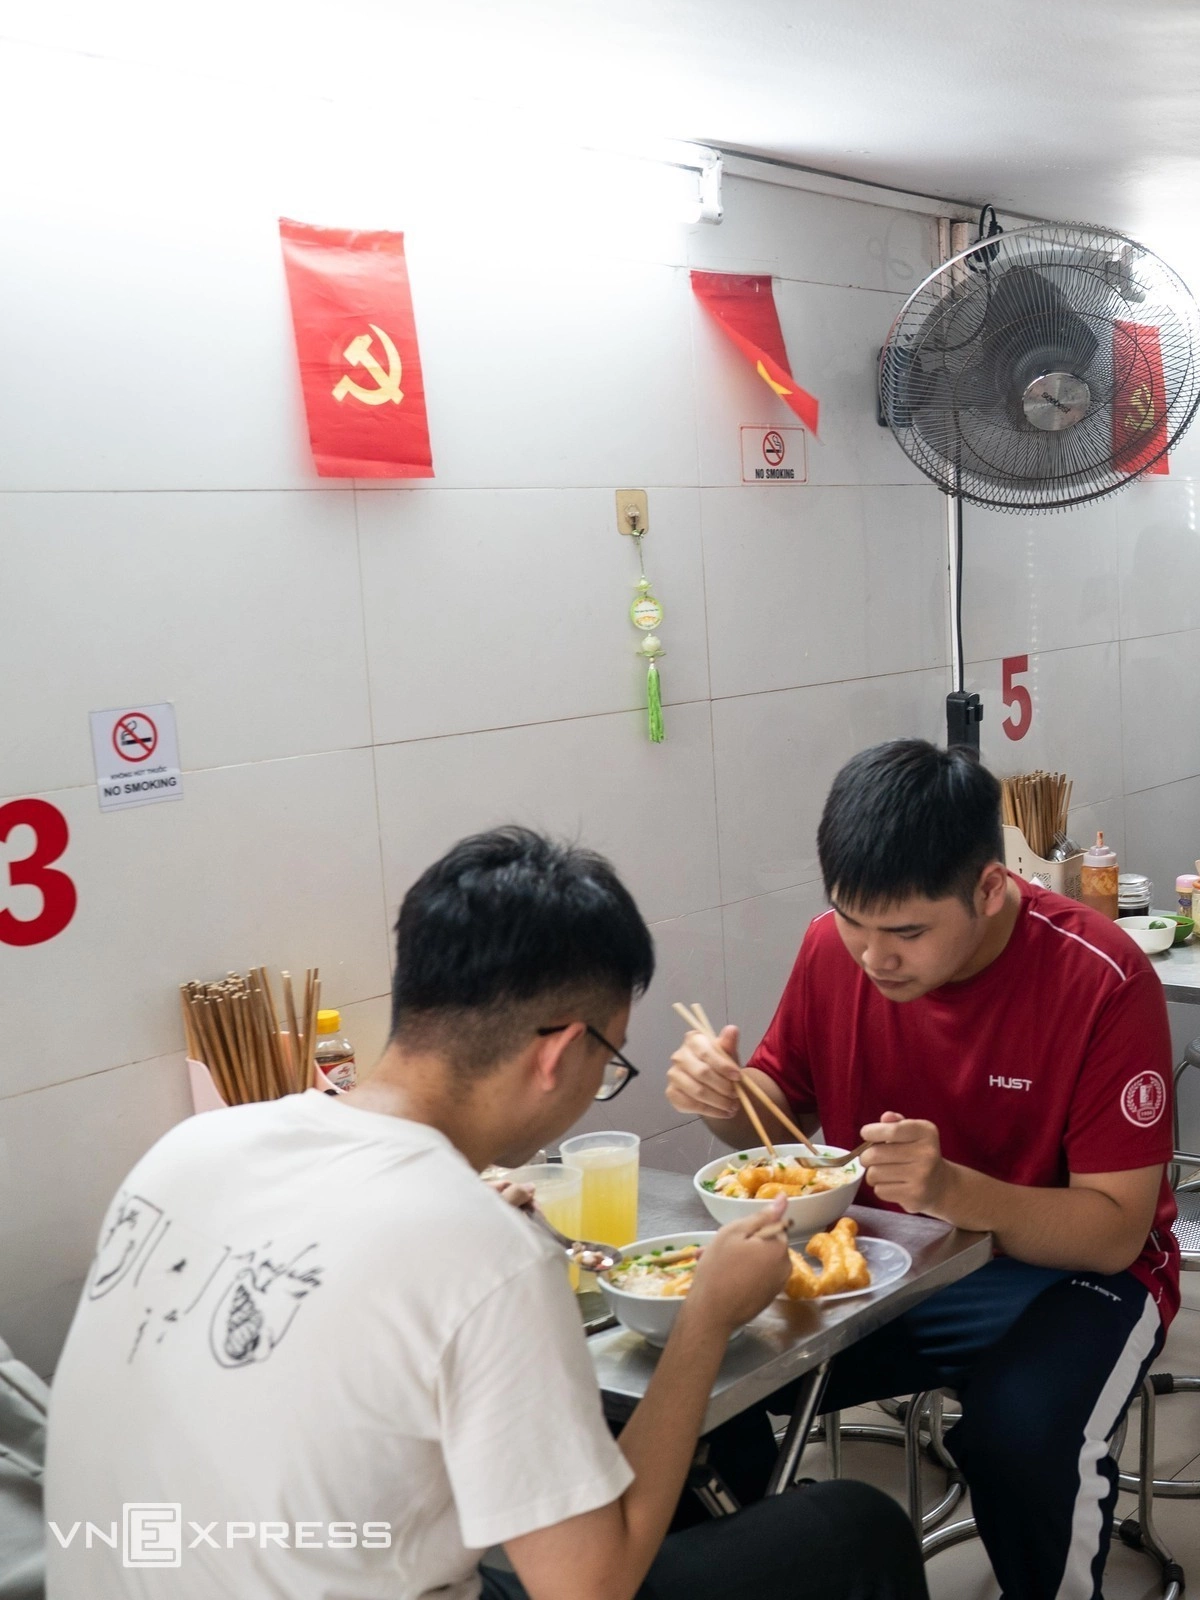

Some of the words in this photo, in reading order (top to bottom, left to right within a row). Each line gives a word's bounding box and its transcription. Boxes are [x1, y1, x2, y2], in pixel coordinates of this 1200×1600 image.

[755, 468, 765, 479] NO
[765, 468, 795, 479] SMOKING
[1002, 654, 1033, 742] 5
[103, 785, 122, 798] NO
[123, 776, 178, 795] SMOKING
[0, 798, 77, 947] 3
[989, 1074, 1033, 1092] HUST
